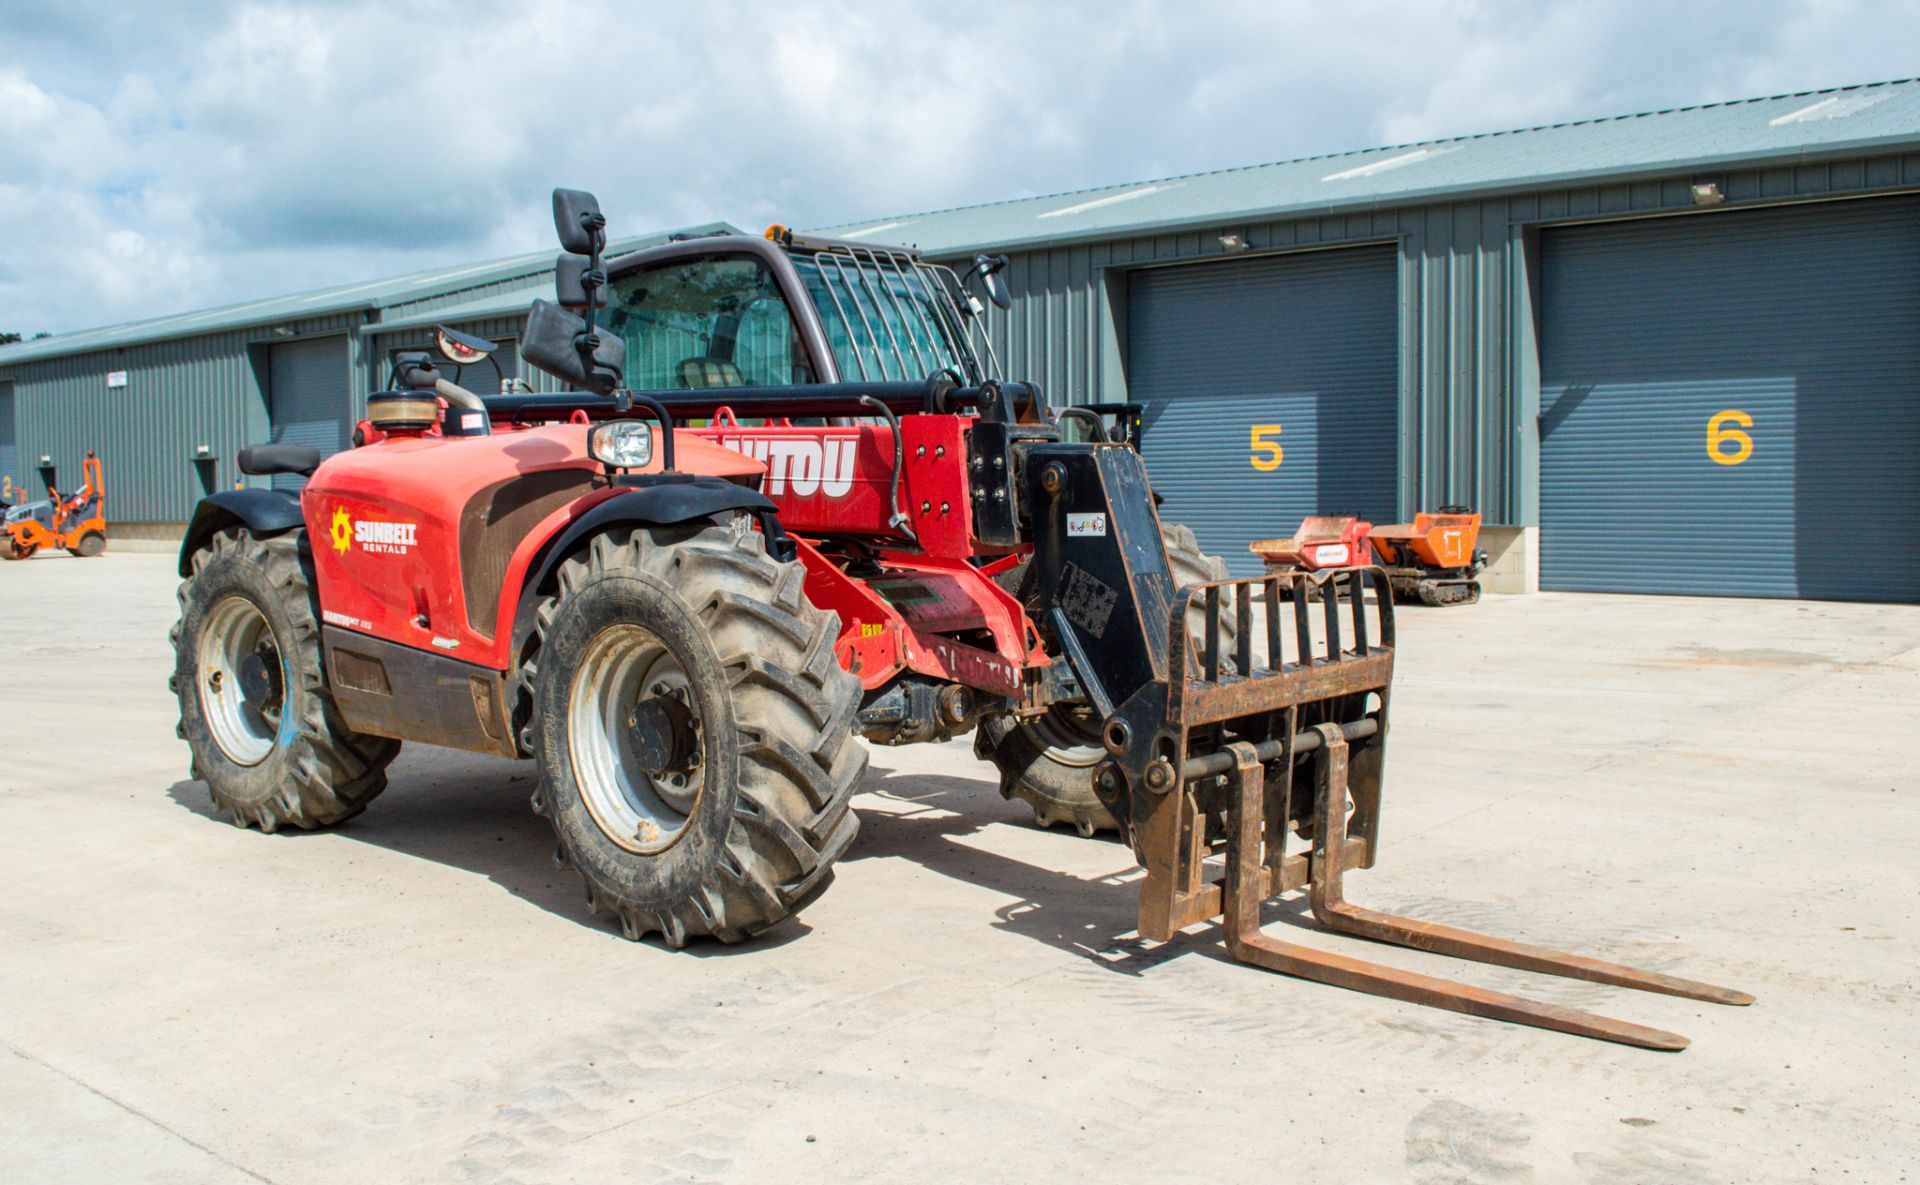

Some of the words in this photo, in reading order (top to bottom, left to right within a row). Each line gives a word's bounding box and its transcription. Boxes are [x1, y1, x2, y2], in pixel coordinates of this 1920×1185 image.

[1250, 425, 1283, 472] 5
[1706, 409, 1754, 466] 6
[2, 475, 13, 498] 2
[354, 520, 417, 546] SUNBELT
[363, 543, 407, 555] RENTALS
